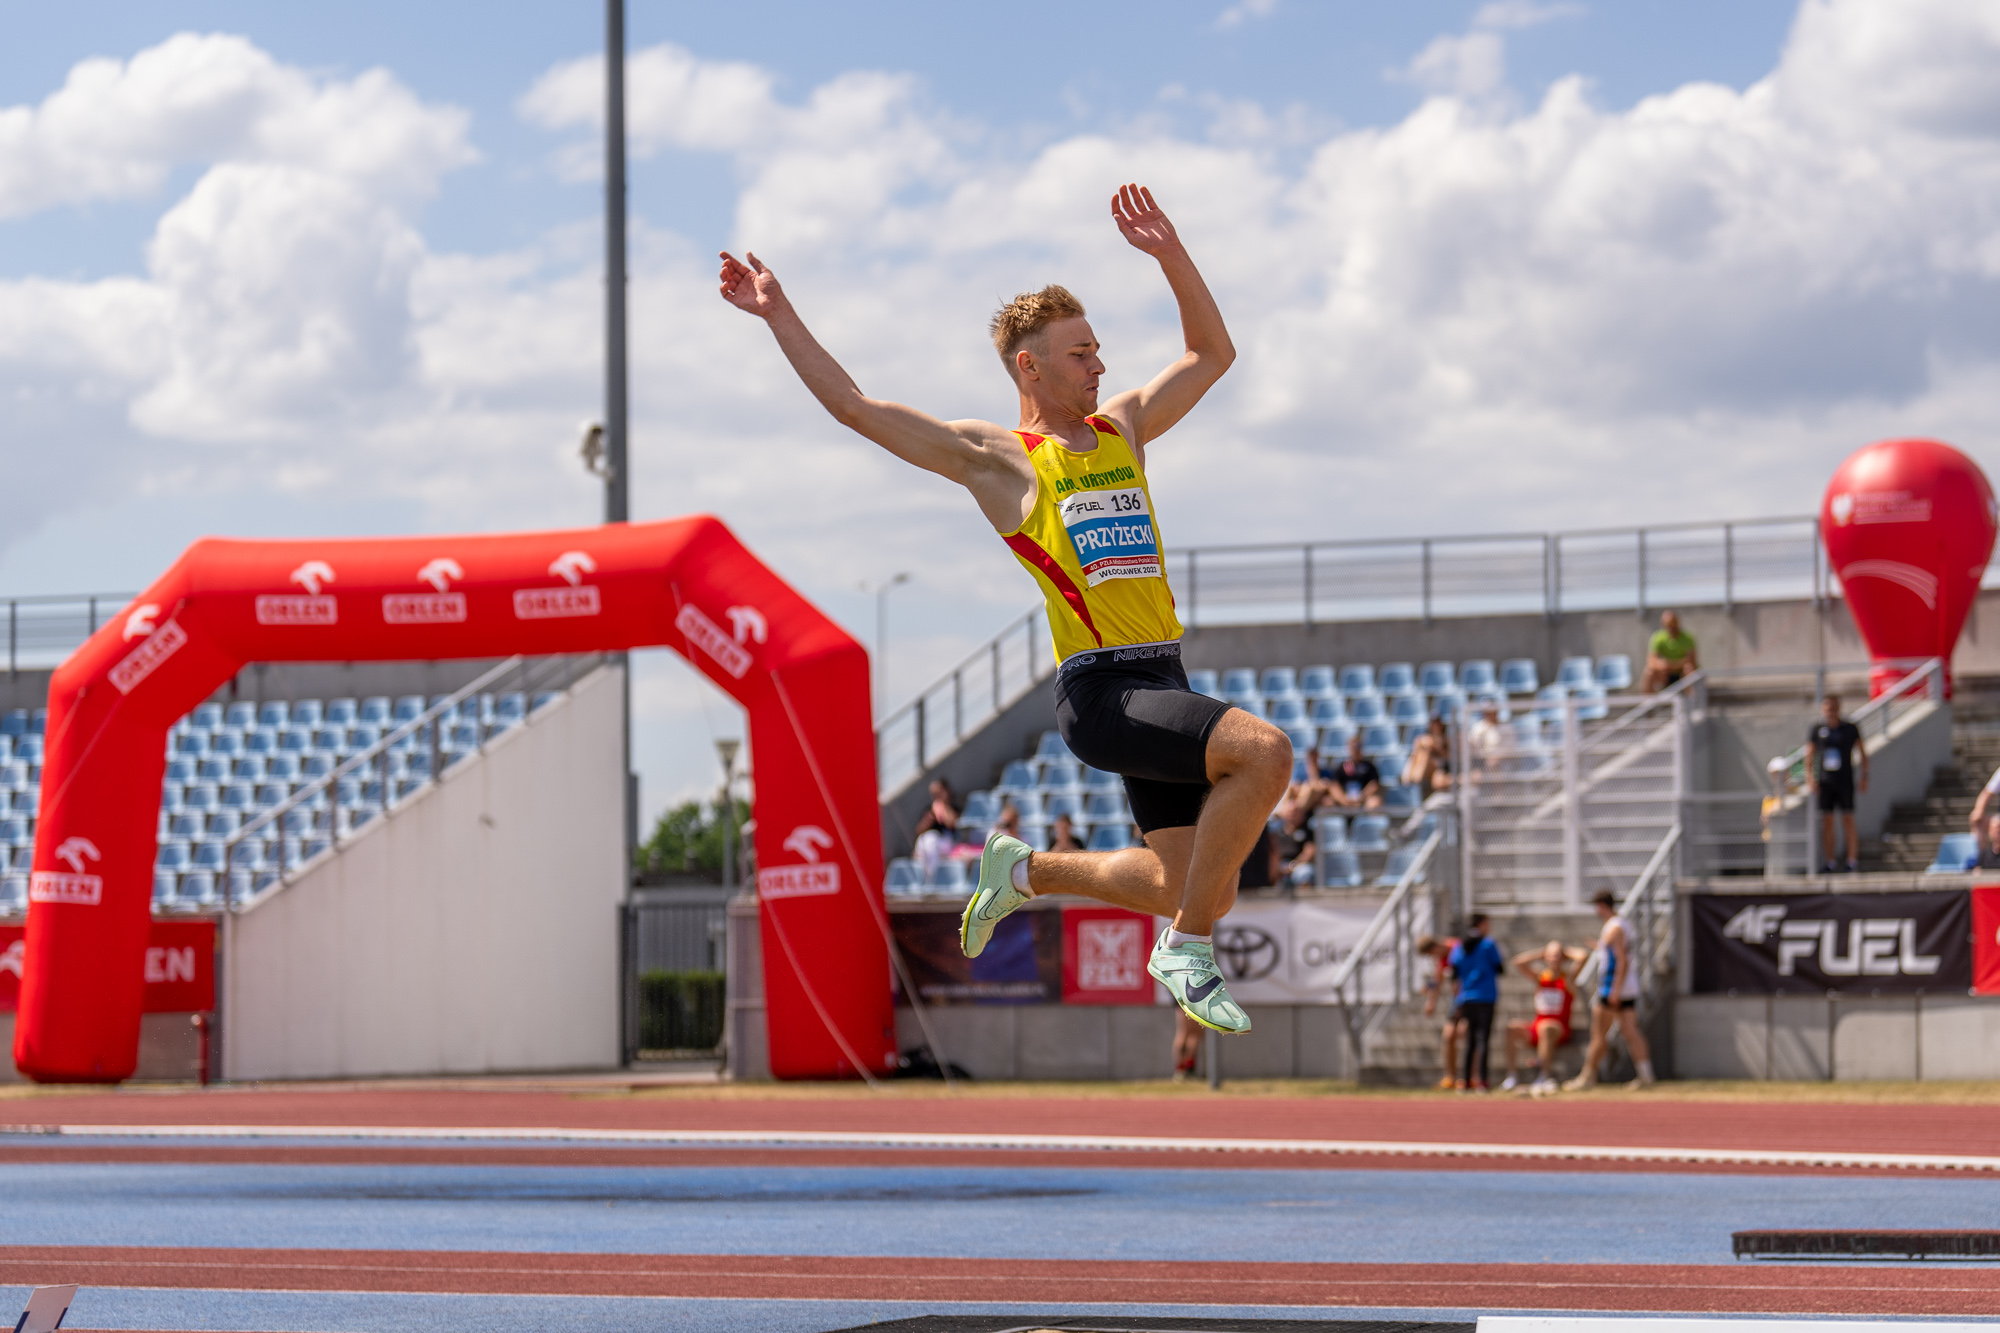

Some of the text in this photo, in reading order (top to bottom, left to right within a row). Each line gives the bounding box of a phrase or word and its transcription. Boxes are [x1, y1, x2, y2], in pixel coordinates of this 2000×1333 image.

[1079, 465, 1136, 489] URSYNÓW
[1076, 501, 1105, 514] FUEL
[1110, 493, 1141, 512] 136
[1073, 521, 1155, 555] PRZYŻECKI
[1098, 566, 1142, 578] WŁOCŁAWEK
[1113, 644, 1180, 662] NIKE PRO
[1722, 903, 1788, 944] 4F
[1777, 918, 1942, 977] FUEL
[1185, 958, 1215, 971] NIKE
